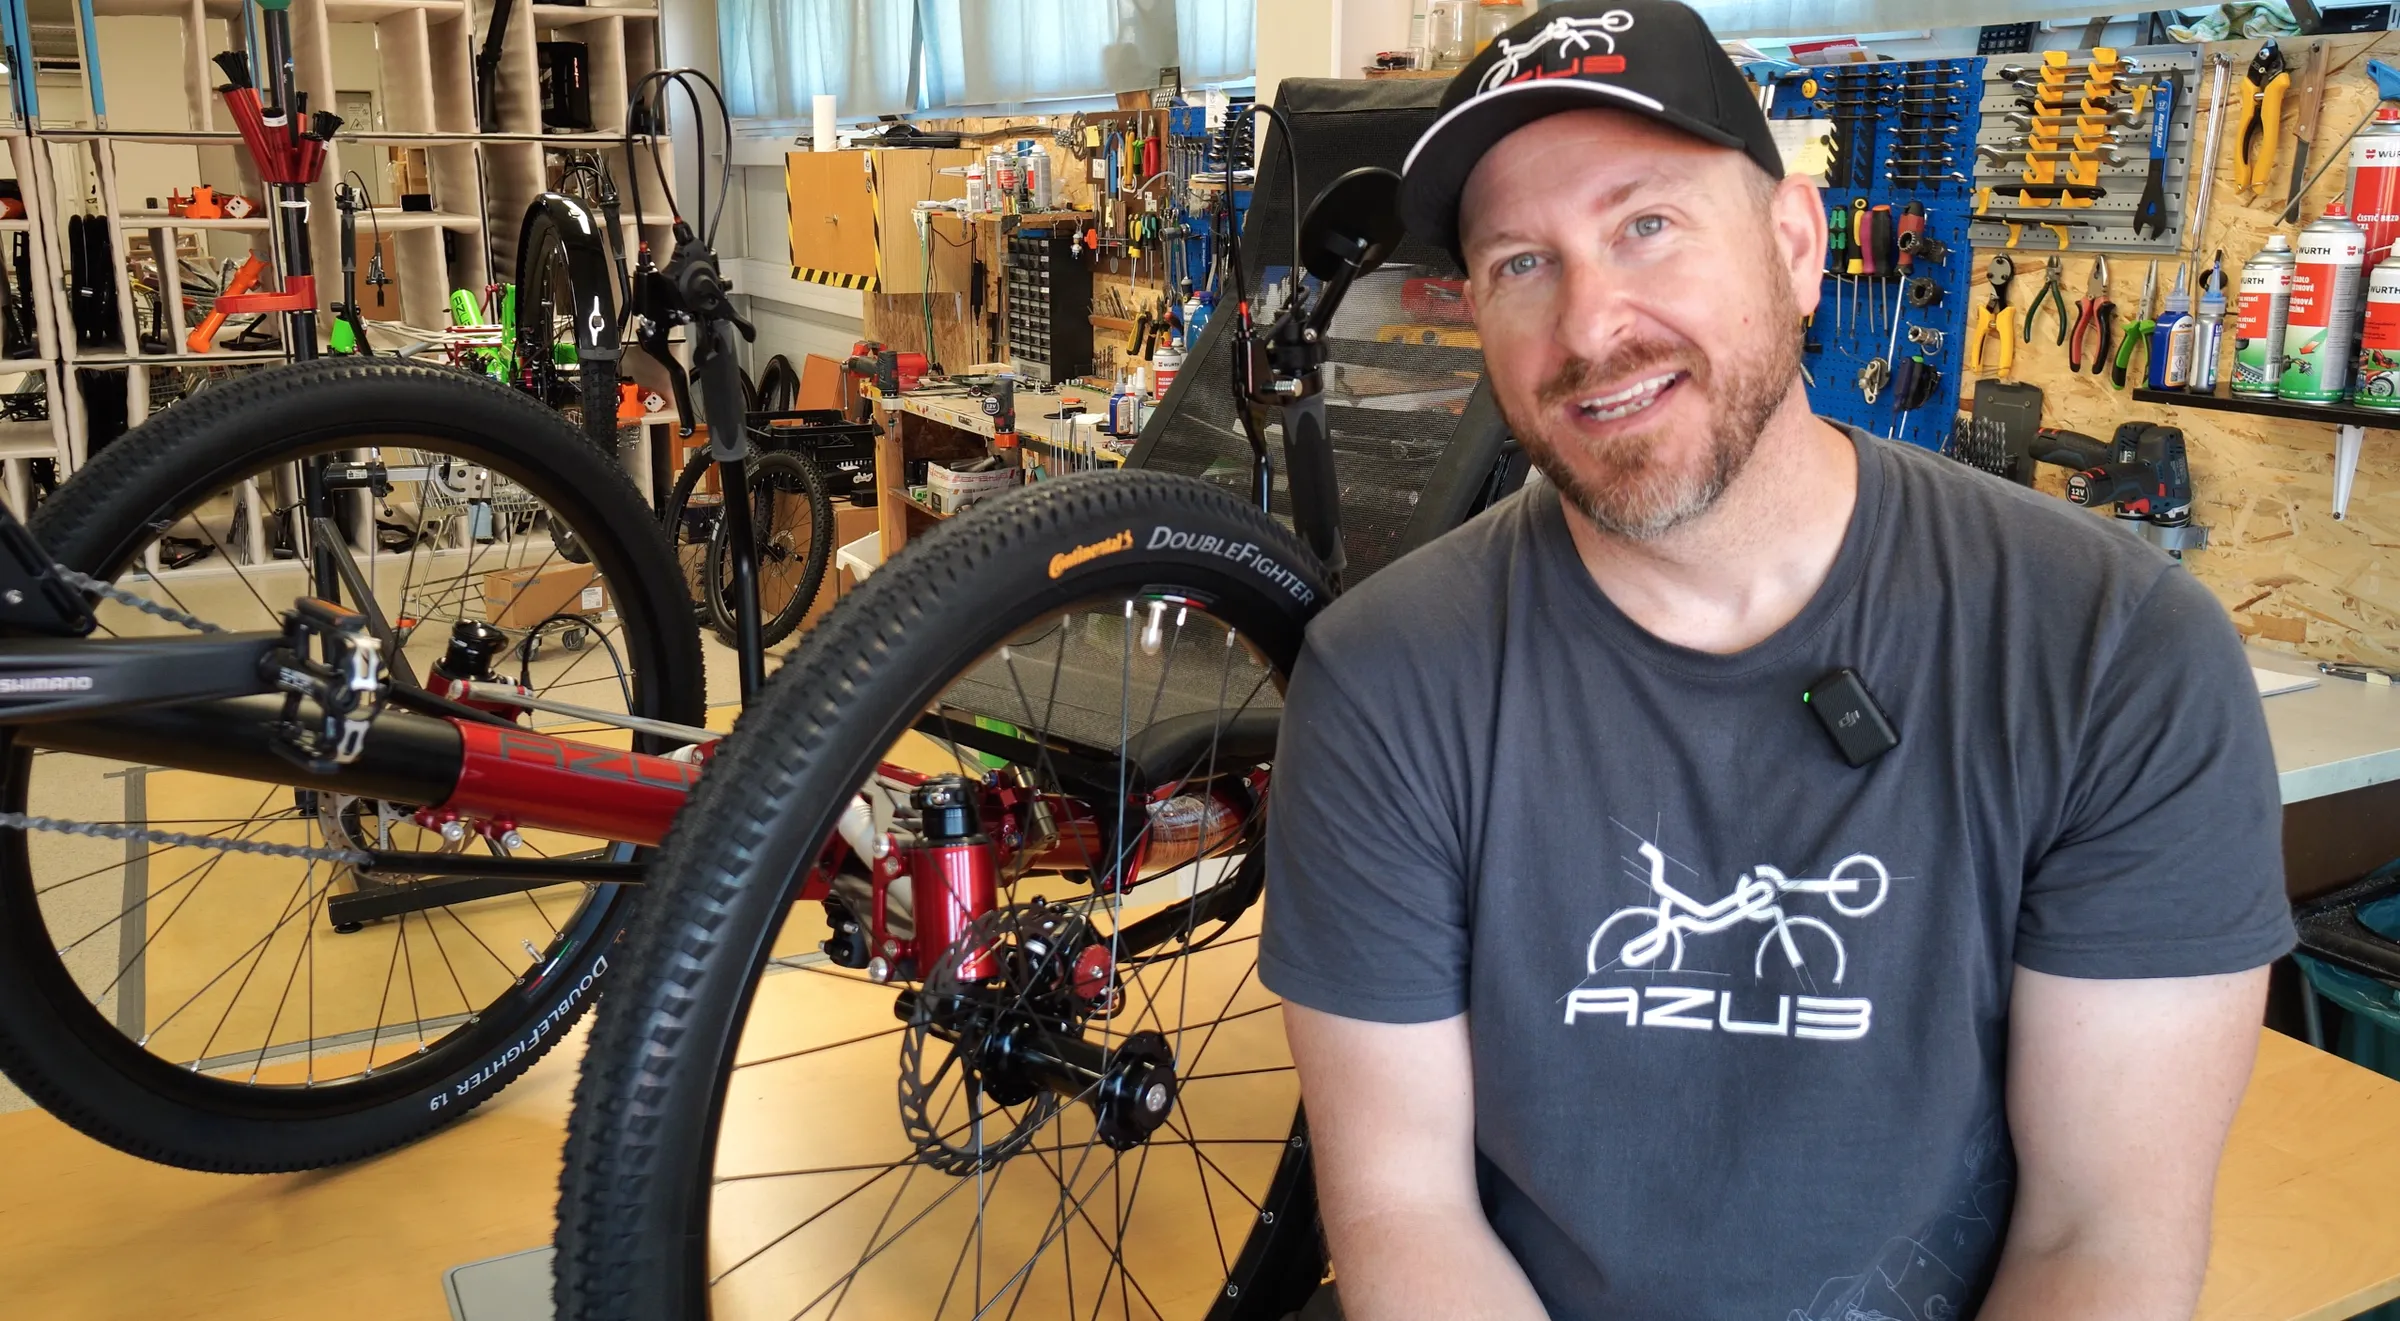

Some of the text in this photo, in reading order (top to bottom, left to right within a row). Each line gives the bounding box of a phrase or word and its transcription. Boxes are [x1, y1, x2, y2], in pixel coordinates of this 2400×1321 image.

[452, 296, 471, 326] AZU
[2071, 487, 2085, 497] 12V
[0, 676, 94, 693] SHIMANO
[500, 731, 702, 792] AZU
[1563, 986, 1873, 1040] AZUB
[429, 1092, 449, 1111] 1.9
